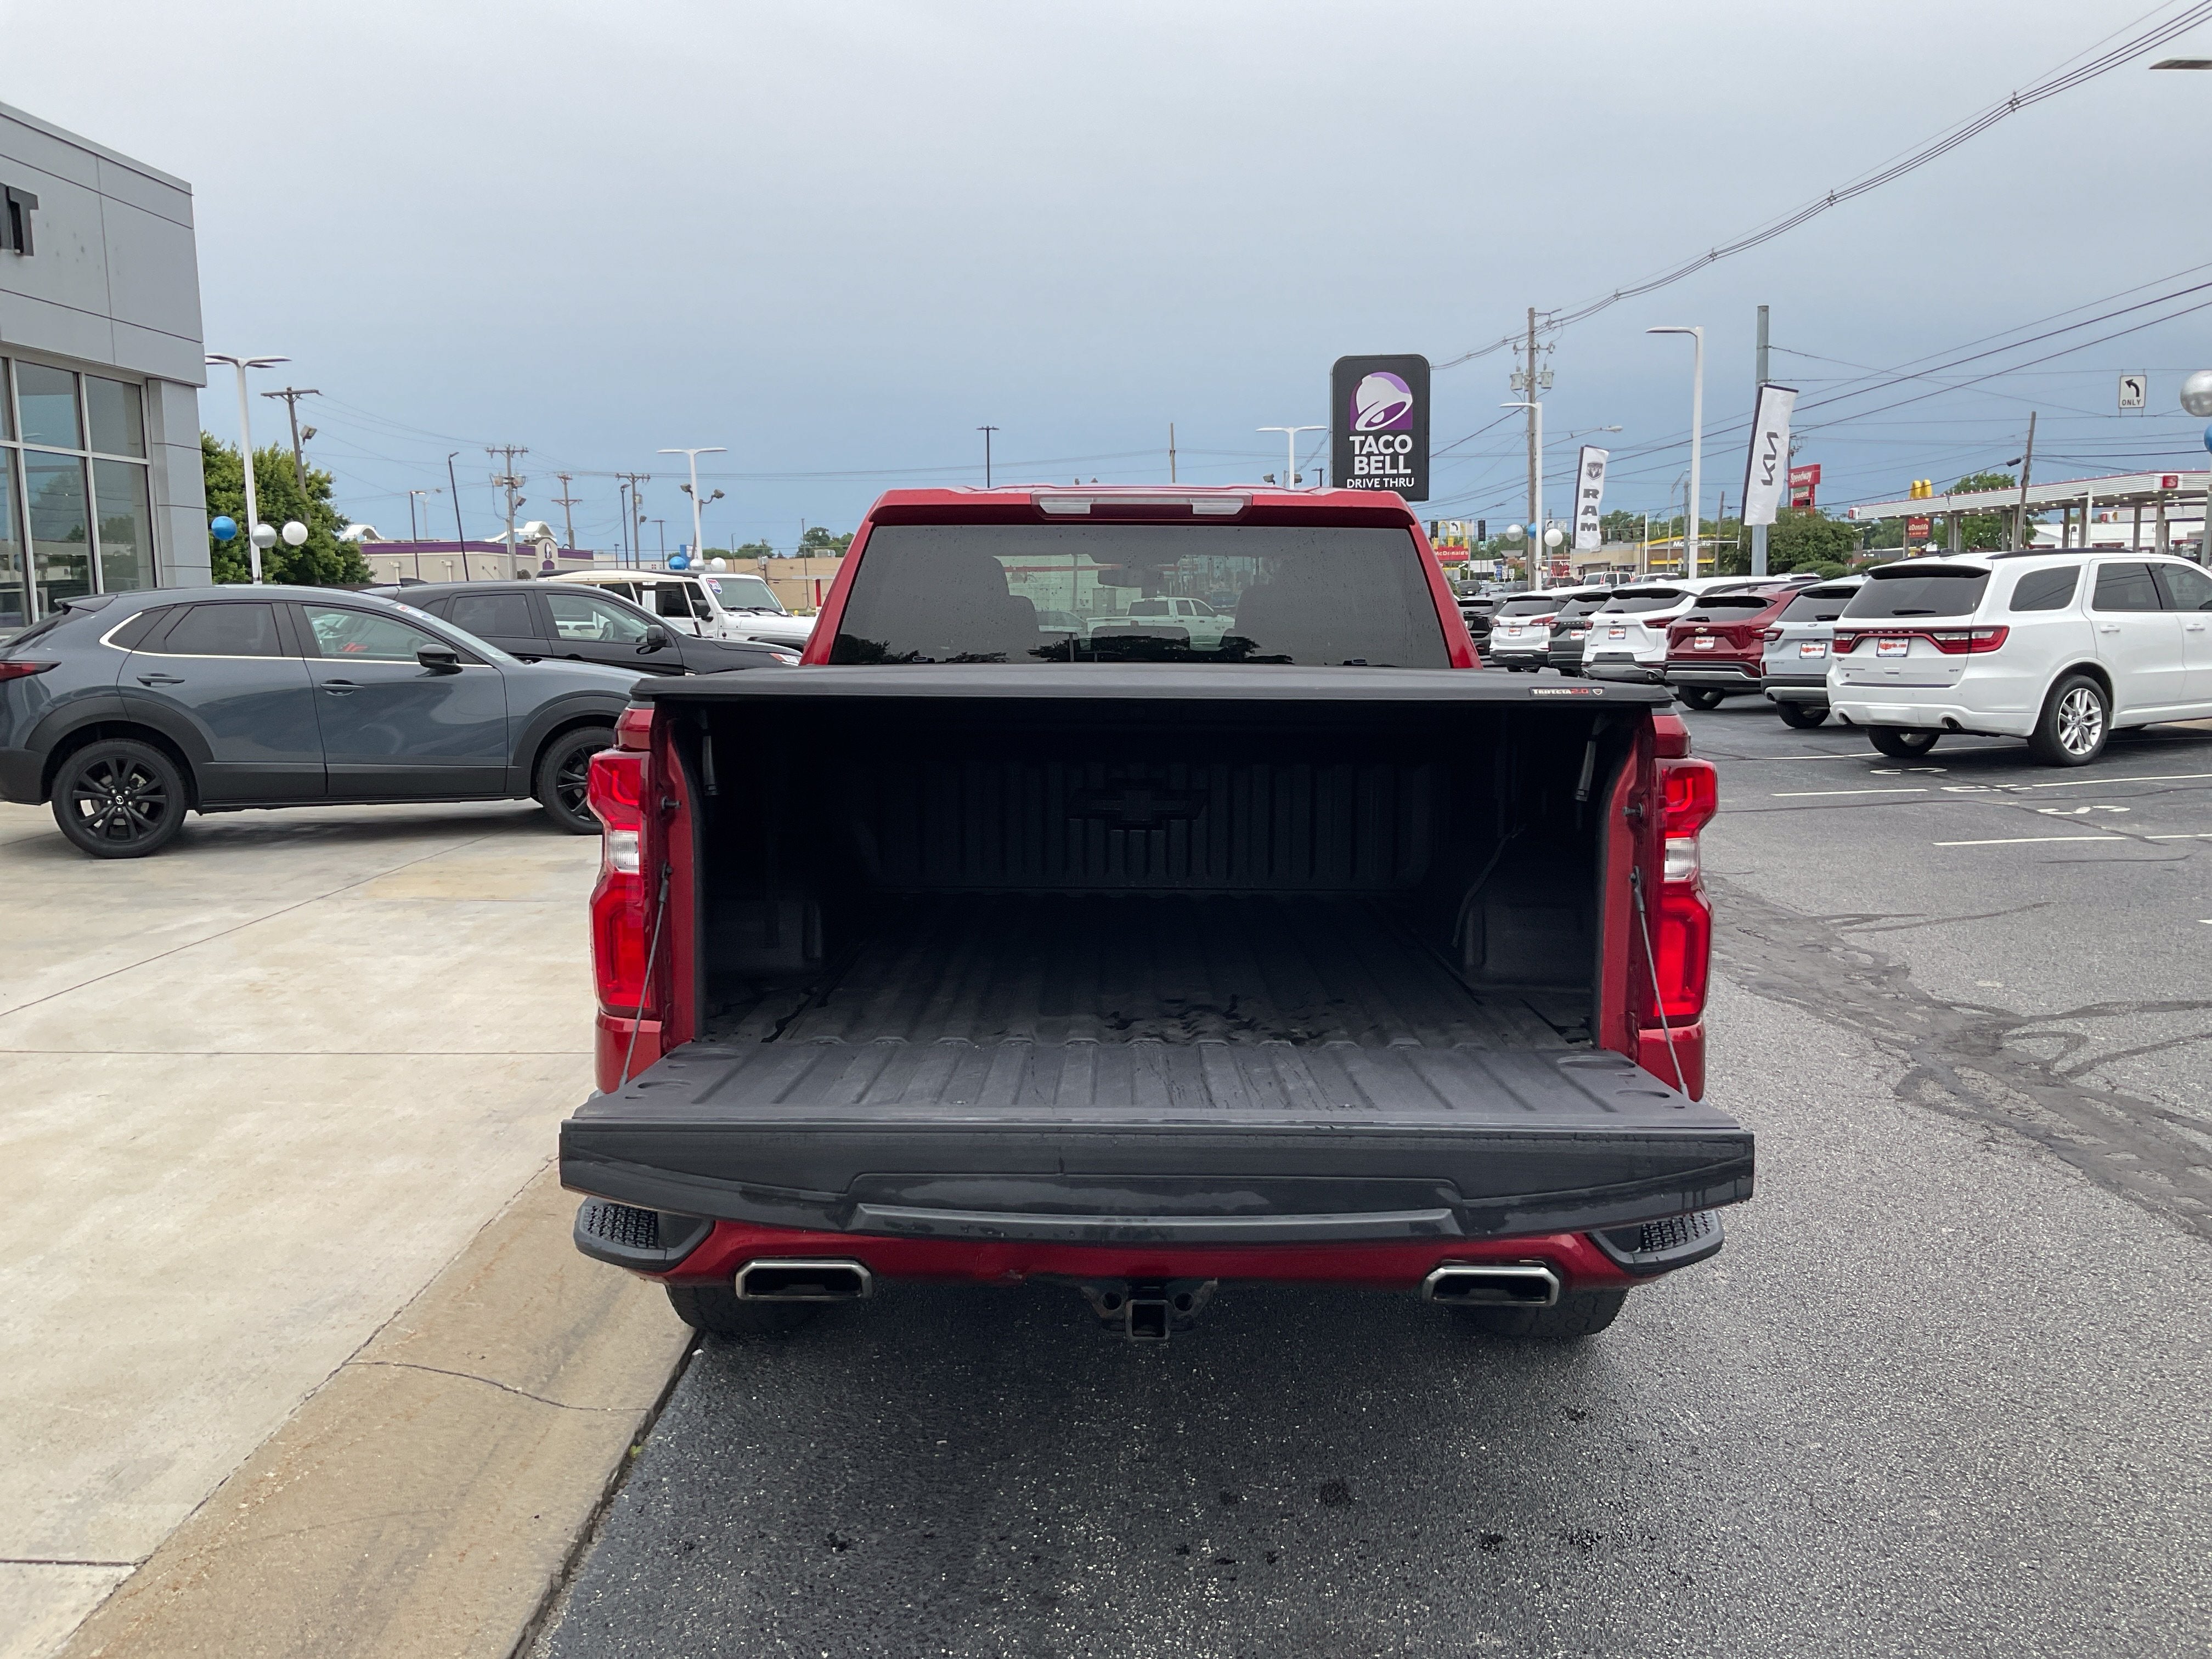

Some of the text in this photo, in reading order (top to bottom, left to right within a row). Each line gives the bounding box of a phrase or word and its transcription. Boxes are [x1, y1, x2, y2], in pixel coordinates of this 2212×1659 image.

[1349, 435, 1412, 454] TACO
[1355, 455, 1412, 475] BELL
[1347, 477, 1414, 488] DRIVE THRU
[1790, 471, 1812, 484] Speedway
[1581, 489, 1599, 531] RAM
